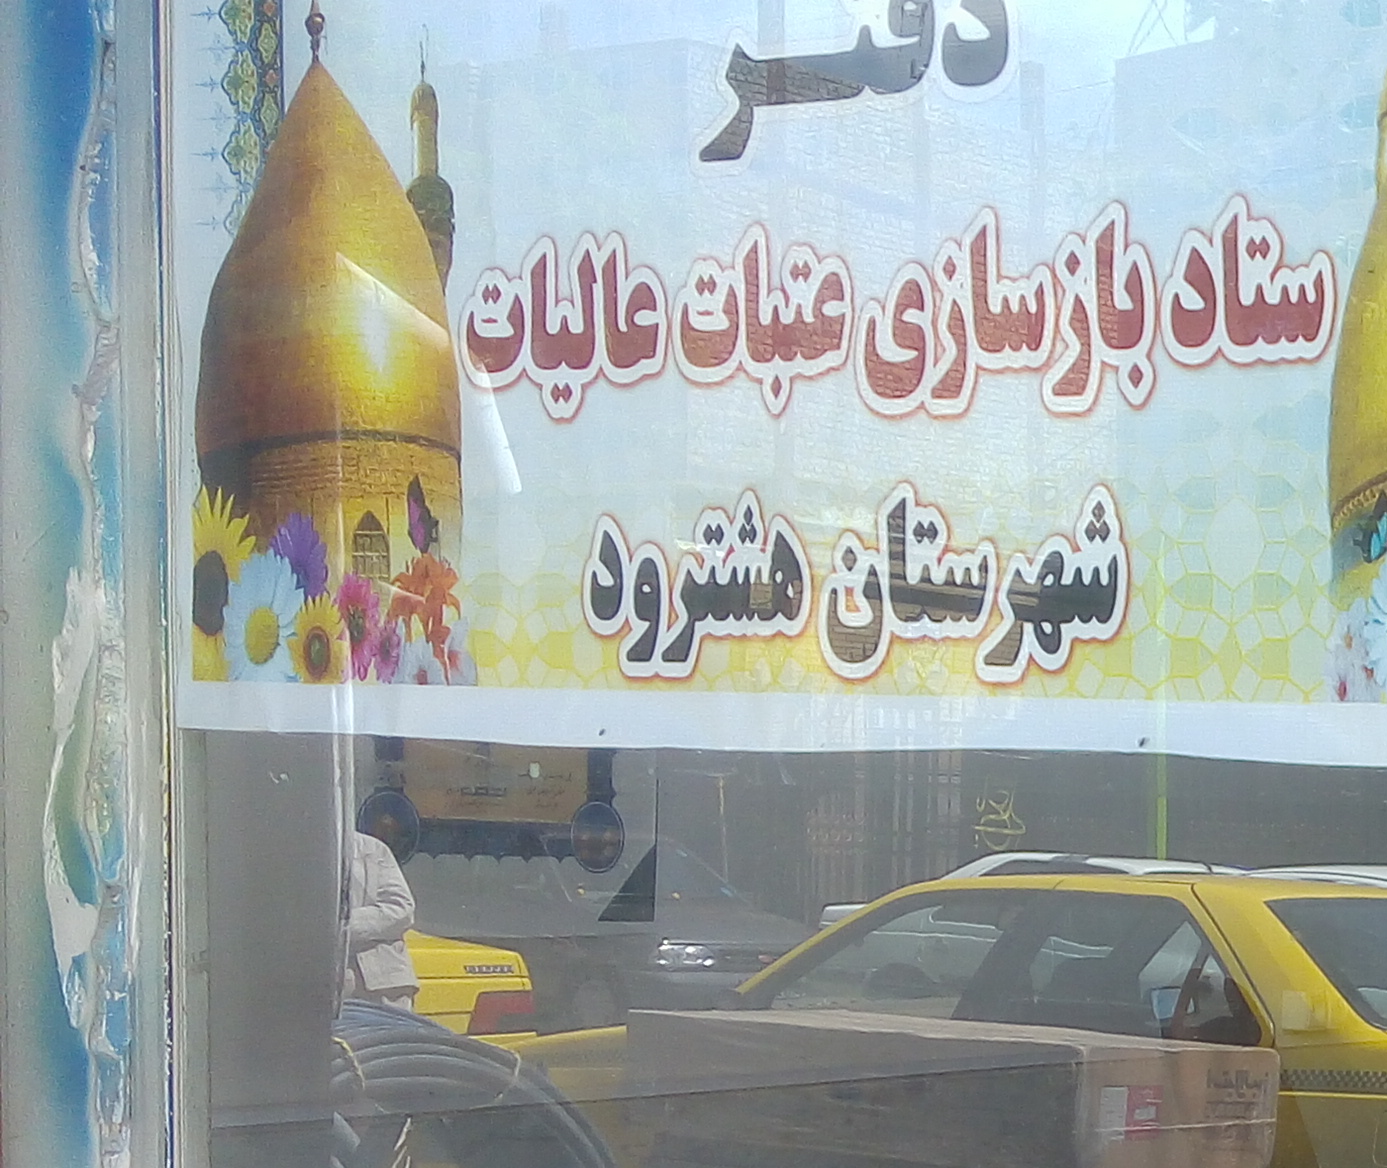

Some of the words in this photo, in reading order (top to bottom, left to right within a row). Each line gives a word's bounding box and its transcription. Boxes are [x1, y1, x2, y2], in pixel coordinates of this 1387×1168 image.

[460, 232, 668, 420] عالیات
[672, 223, 854, 414] عتبات
[1162, 195, 1336, 368] ستاد
[583, 488, 812, 680] هشترود
[820, 481, 1130, 683] شهرستان
